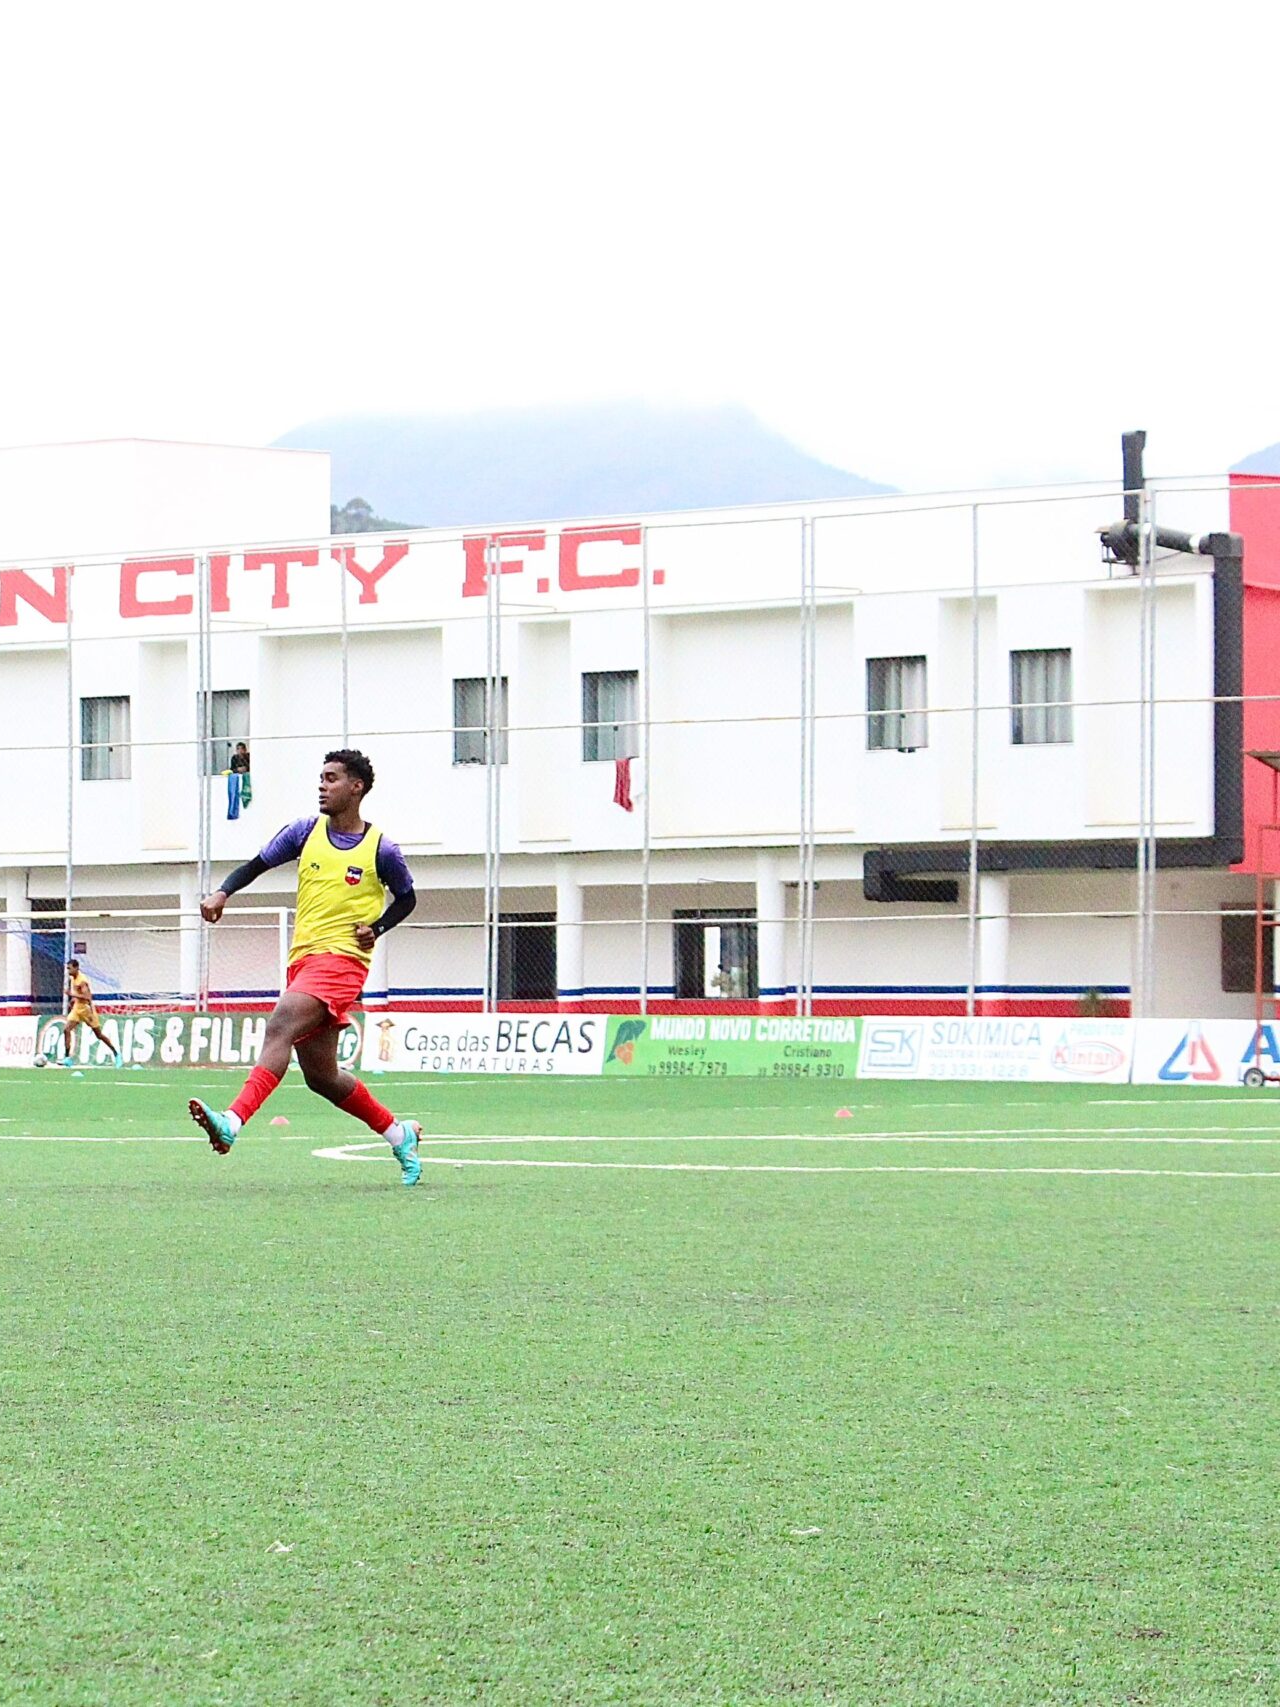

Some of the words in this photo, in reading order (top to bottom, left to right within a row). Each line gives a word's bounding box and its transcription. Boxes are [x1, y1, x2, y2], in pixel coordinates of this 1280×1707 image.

[119, 539, 410, 618] CITY
[462, 523, 666, 598] F.C.
[80, 1017, 156, 1064] PAIS
[160, 1016, 185, 1064] &
[189, 1017, 268, 1064] FILH
[403, 1027, 451, 1052] Casa
[457, 1029, 491, 1052] das
[496, 1020, 596, 1054] BECAS
[650, 1017, 706, 1040] MUNDO
[709, 1018, 752, 1041] NOVO
[754, 1019, 856, 1043] CORRETORA
[930, 1021, 1042, 1046] SOKIMICA
[4, 1036, 34, 1056] 4800
[668, 1045, 707, 1059] Wesley
[783, 1045, 832, 1058] Cristiano
[420, 1056, 555, 1072] FORMATURAS
